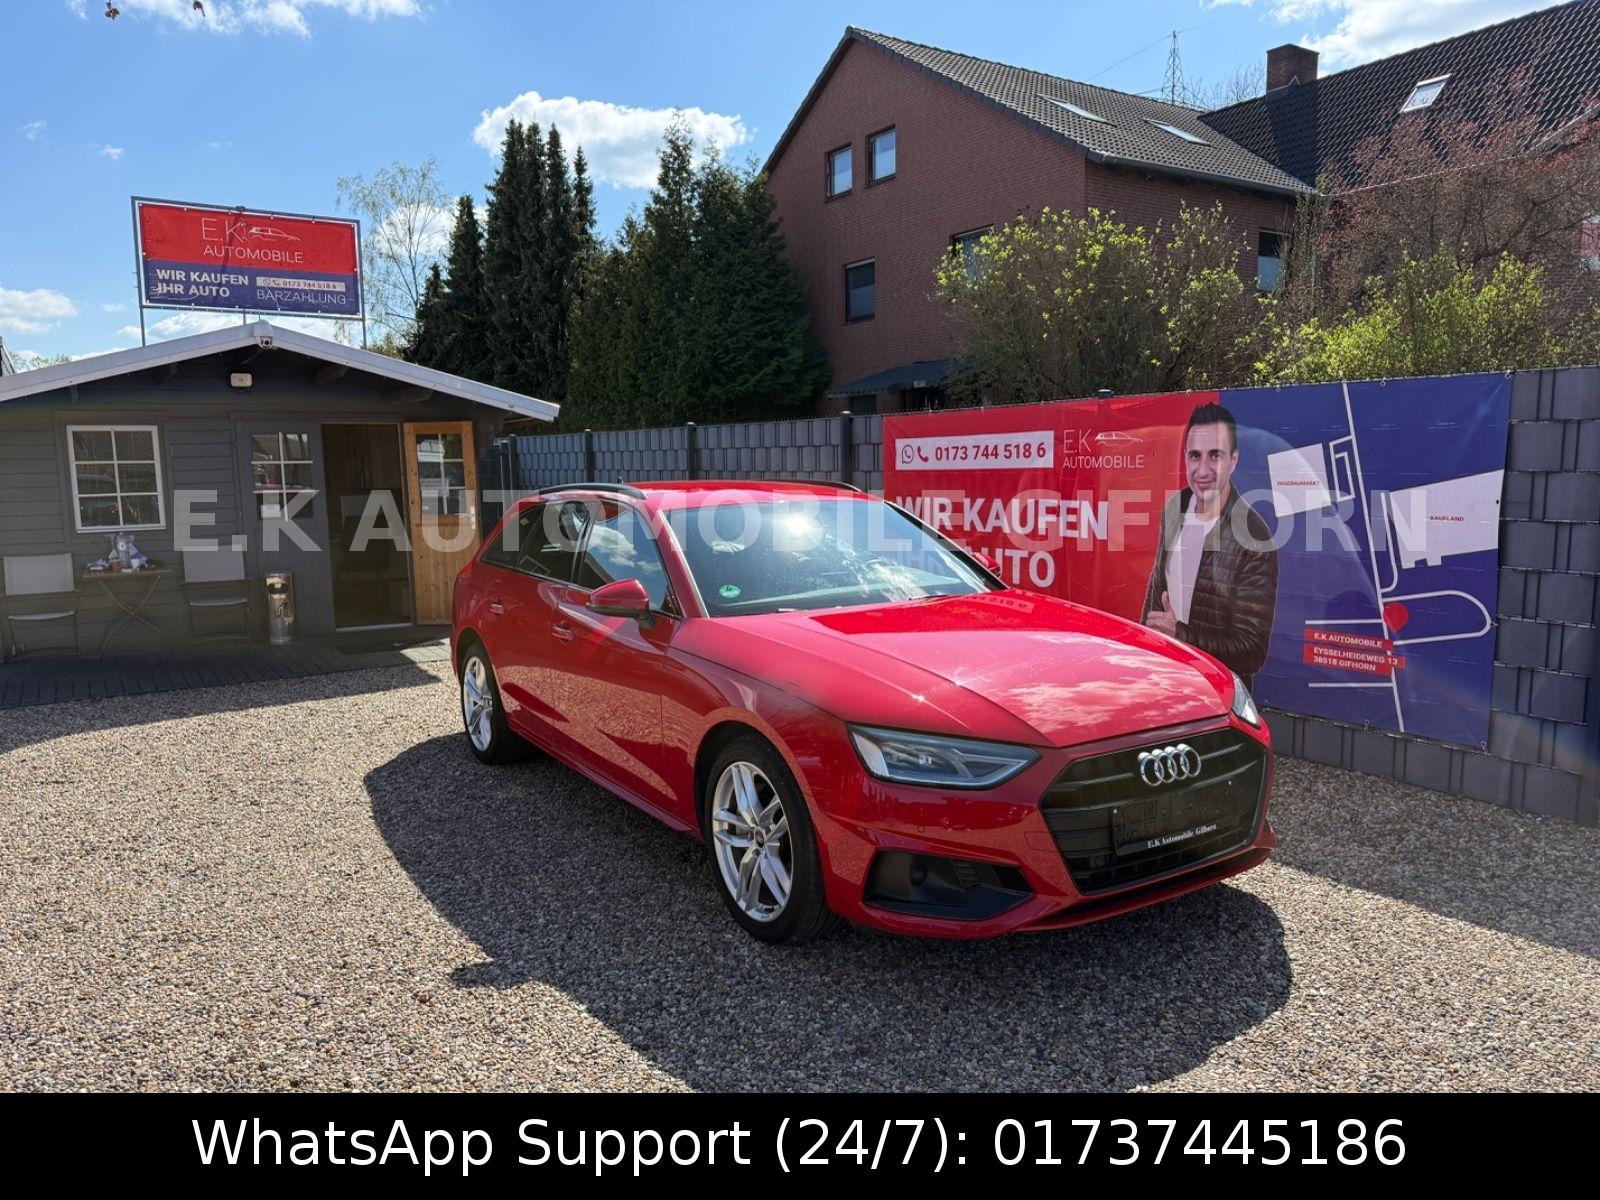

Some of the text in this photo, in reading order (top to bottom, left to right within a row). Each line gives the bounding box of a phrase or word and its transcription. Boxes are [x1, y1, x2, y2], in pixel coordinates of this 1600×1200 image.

[203, 244, 304, 264] AUTOMOBILE
[156, 268, 249, 286] WIR KAUFEN
[156, 282, 231, 298] IHR AUTO
[256, 289, 346, 304] BARZAHLUNG
[934, 442, 1047, 462] 0173 744 518 6
[1062, 454, 1145, 469] AUTOMOBILE
[963, 497, 1109, 541] KAUFEN
[1328, 634, 1382, 648] AUTOMOBILE
[1313, 646, 1385, 664] EYSSELHEIDEWEG
[1313, 656, 1376, 671] 38518 GIFHORN
